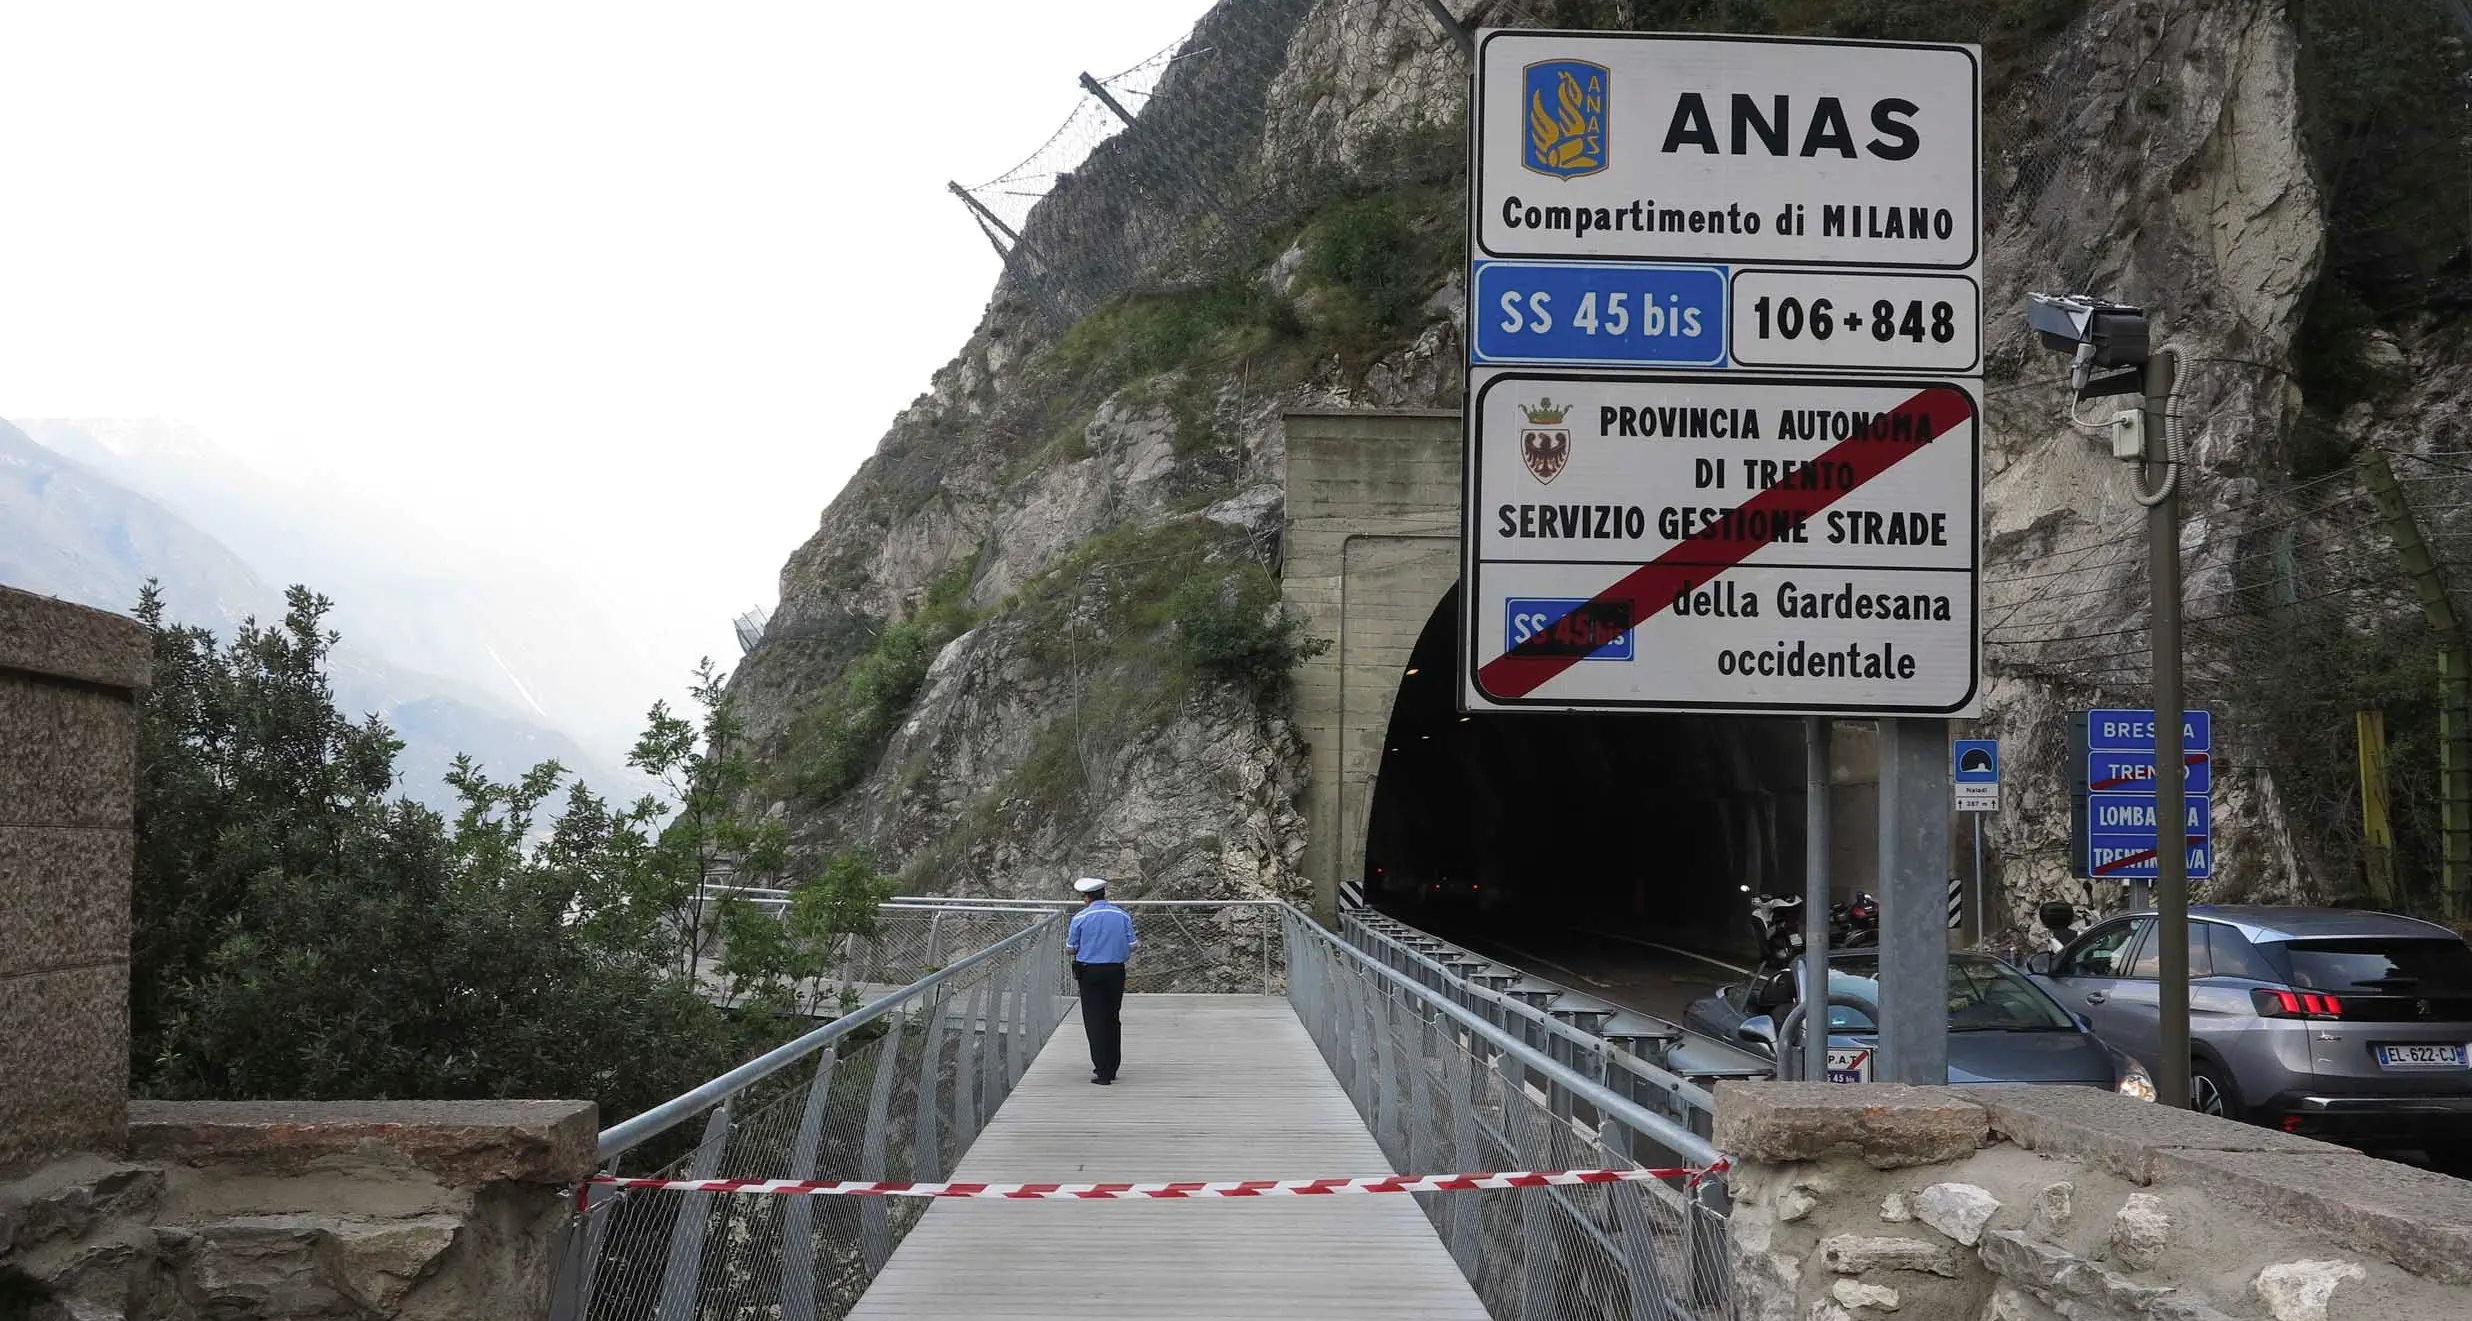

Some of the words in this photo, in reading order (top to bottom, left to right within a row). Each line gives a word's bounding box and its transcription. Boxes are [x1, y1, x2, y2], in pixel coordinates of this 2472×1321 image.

[1587, 75, 1600, 156] ANAS
[1662, 92, 1920, 161] ANAS
[1503, 196, 1760, 237] Compartimento
[1776, 204, 1804, 236] di
[1824, 205, 1953, 240] MILANO
[1501, 291, 1552, 334] SS
[1573, 292, 1630, 336] 45
[1644, 293, 1702, 337] bis
[1754, 296, 1954, 343] 106+848
[1600, 407, 1760, 439] PROVINCIA
[1778, 410, 1933, 443] AUTONOMA
[1696, 459, 1725, 489] DI
[1744, 459, 1855, 491] TRENTO
[1498, 505, 1645, 540] SERVIZIO
[1658, 508, 1808, 543] GESTIONE
[1827, 512, 1947, 546] STRADE
[1673, 581, 1759, 618] della
[1777, 582, 1951, 622] Gardesana
[1514, 613, 1547, 645] SS
[1718, 642, 1916, 680] occidentale
[2104, 722, 2194, 738] BRESA
[2100, 806, 2199, 826] LOMBAA
[2388, 1048, 2456, 1061] EL-622-CJ
